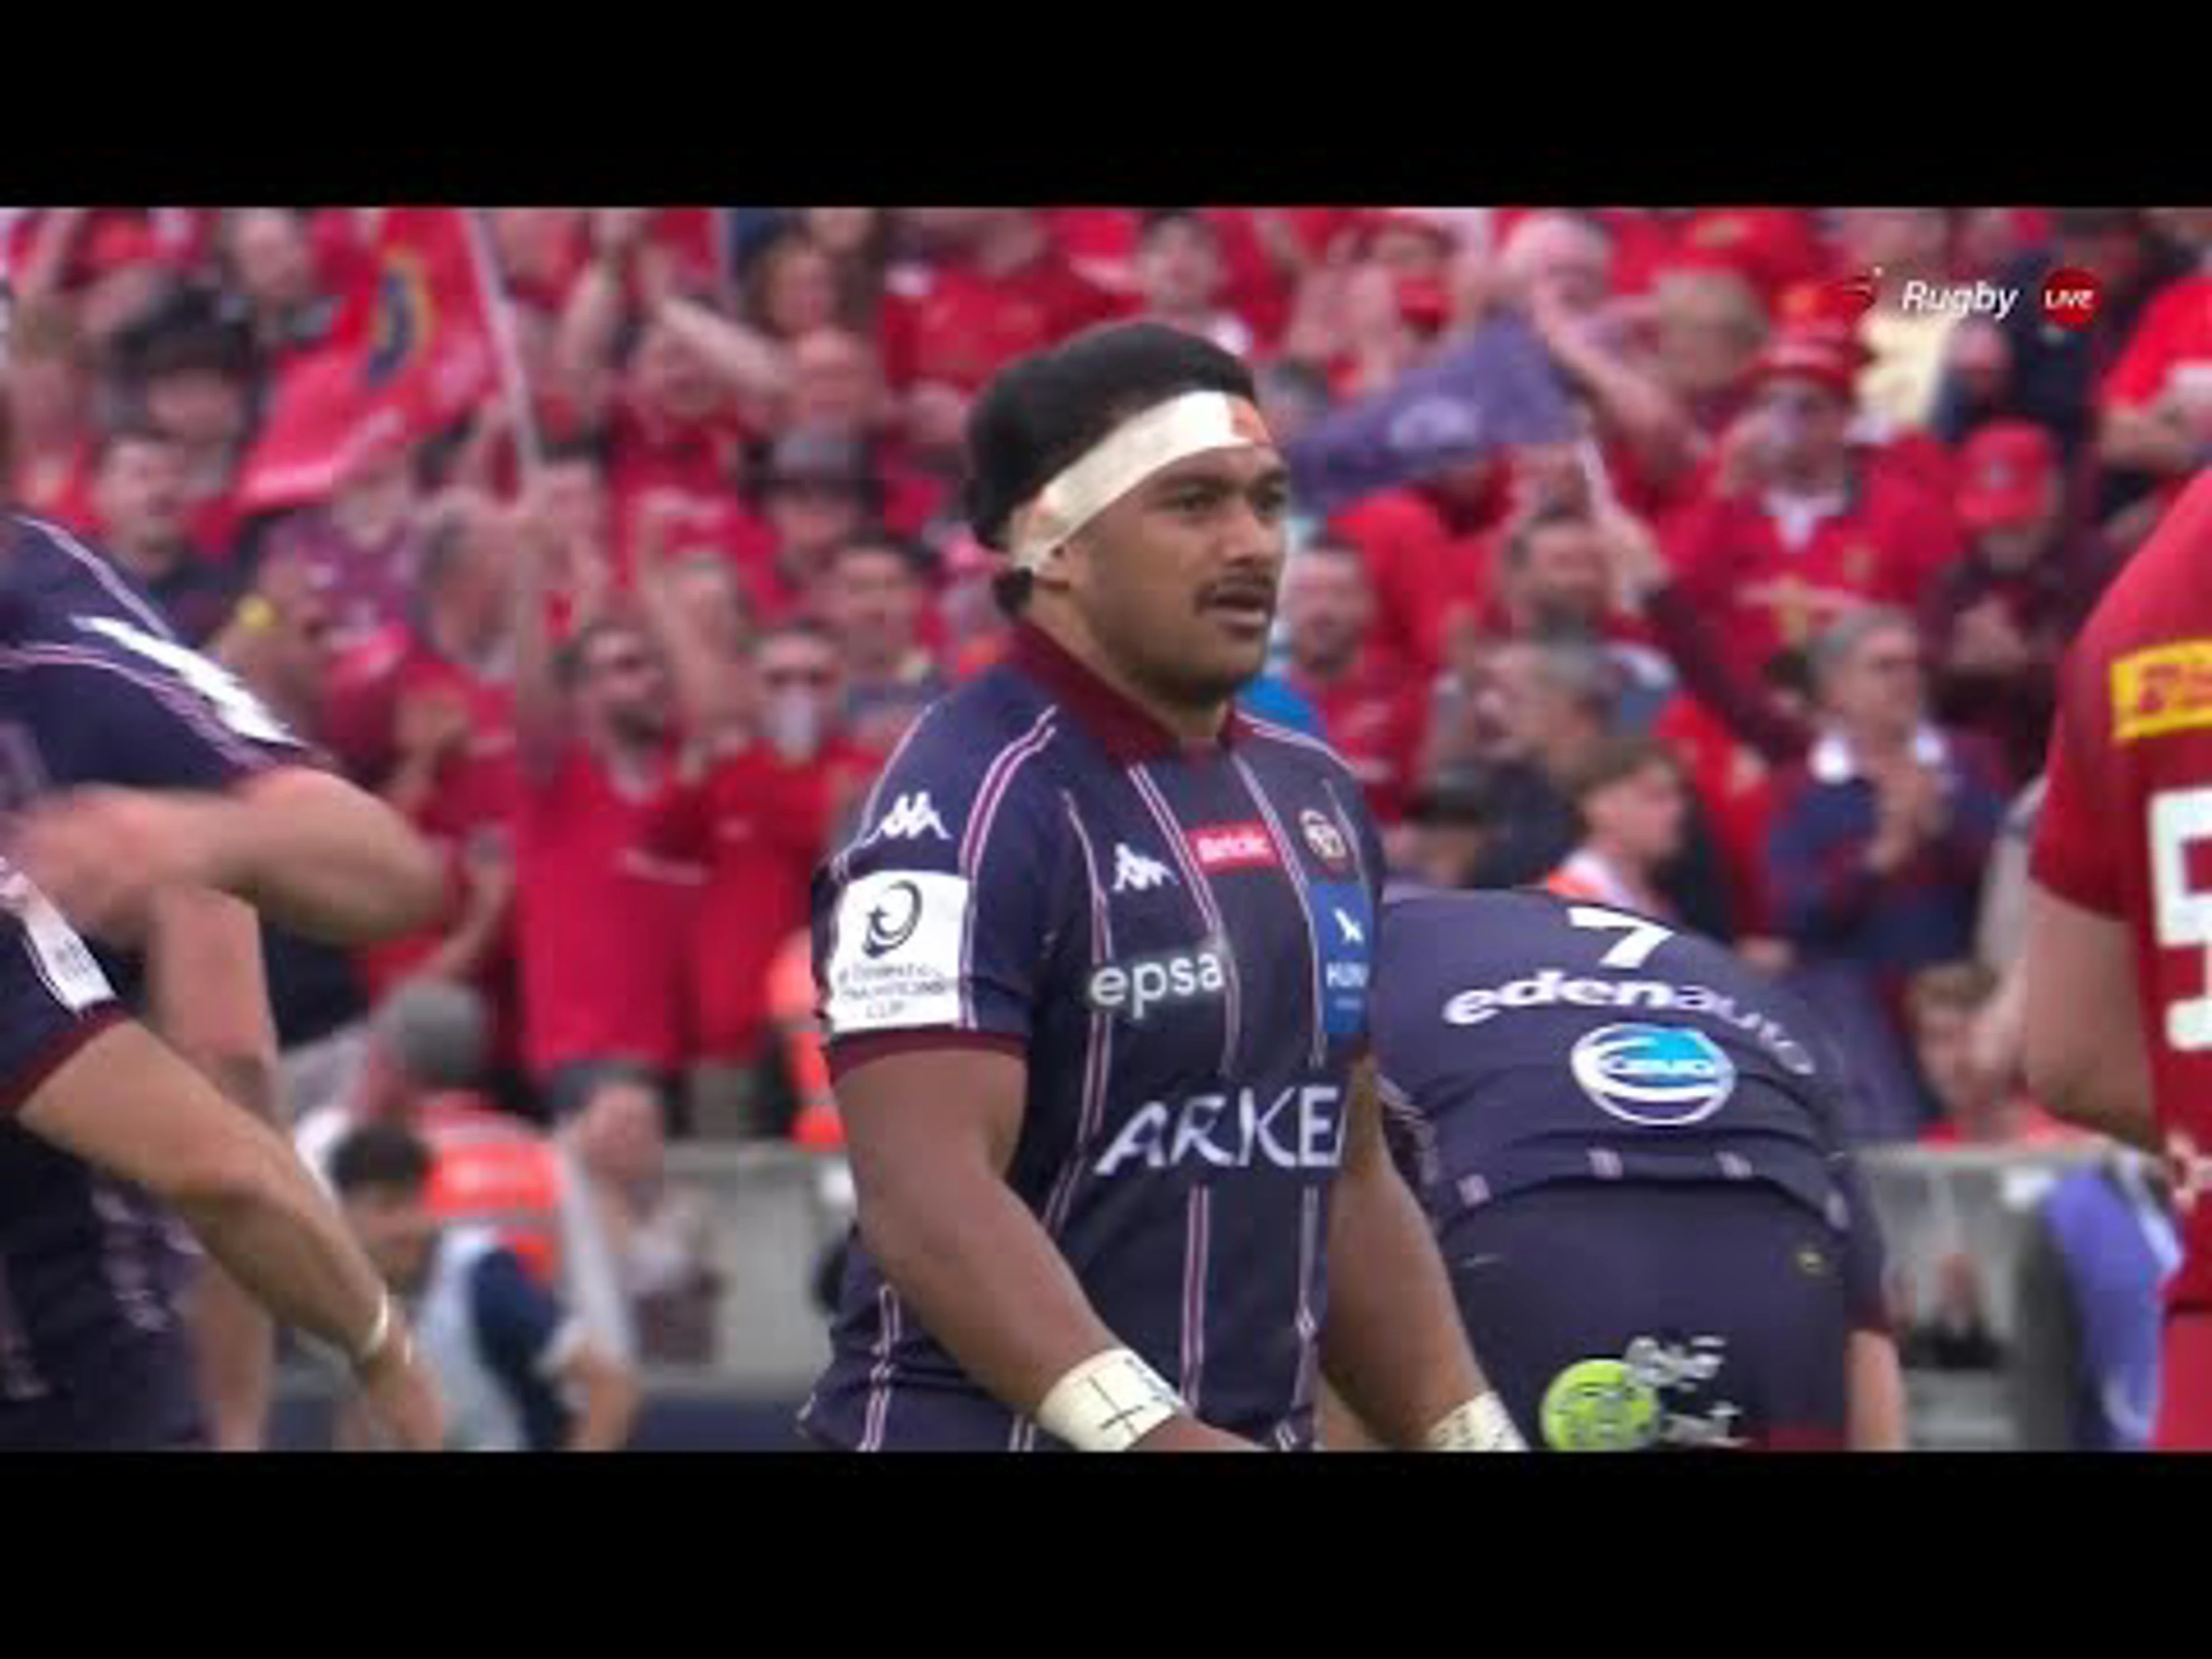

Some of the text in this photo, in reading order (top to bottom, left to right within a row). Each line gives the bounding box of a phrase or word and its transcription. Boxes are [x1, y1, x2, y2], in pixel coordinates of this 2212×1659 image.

[1567, 906, 1675, 969] 7
[1090, 952, 1226, 1019] epsa
[1094, 1085, 1348, 1175] ARKE
